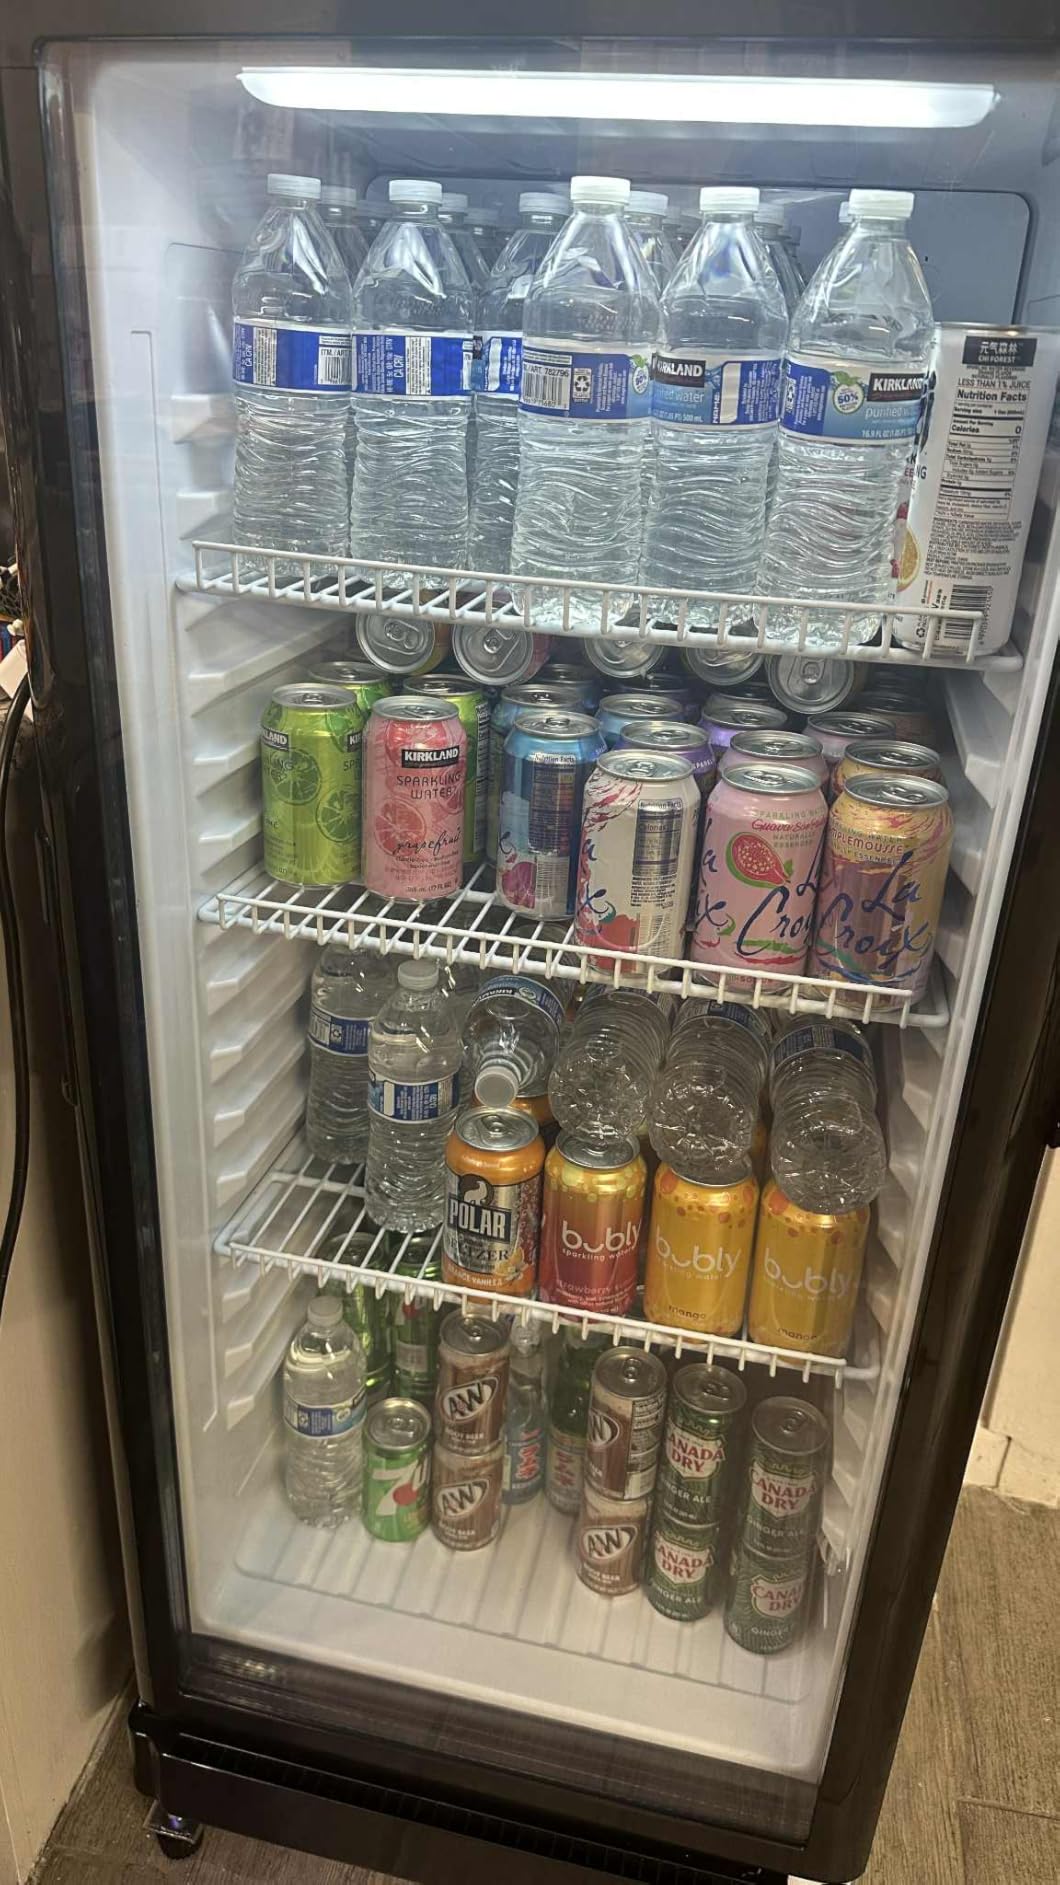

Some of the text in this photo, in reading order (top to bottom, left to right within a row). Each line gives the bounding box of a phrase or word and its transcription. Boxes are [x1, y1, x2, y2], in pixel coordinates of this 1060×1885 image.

[394, 354, 404, 378] CA CRV
[957, 378, 975, 387] LESS
[978, 379, 995, 388] THAN
[1009, 380, 1031, 389] JUICE
[957, 389, 1028, 402] Nutrition Facts
[951, 425, 1022, 434] Calories 0
[264, 730, 288, 745] LAND
[404, 748, 459, 762] KIRKLAND
[397, 771, 461, 787] SPARKLING
[861, 850, 923, 922] La
[736, 885, 810, 956] Cro
[449, 1199, 507, 1239] POLAR
[562, 1219, 641, 1252] bubly
[562, 1248, 605, 1262] sparkling
[656, 1226, 741, 1278] bubly
[764, 1247, 850, 1298] bubly
[669, 1305, 707, 1319] mango
[668, 1433, 724, 1462] ANADA
[672, 1449, 704, 1473] DRY
[663, 1479, 712, 1503] NGER ALE
[762, 1492, 797, 1510] DRY
[657, 1545, 714, 1569] ANADA
[662, 1558, 695, 1578] DRY
[752, 1586, 802, 1603] CANA
